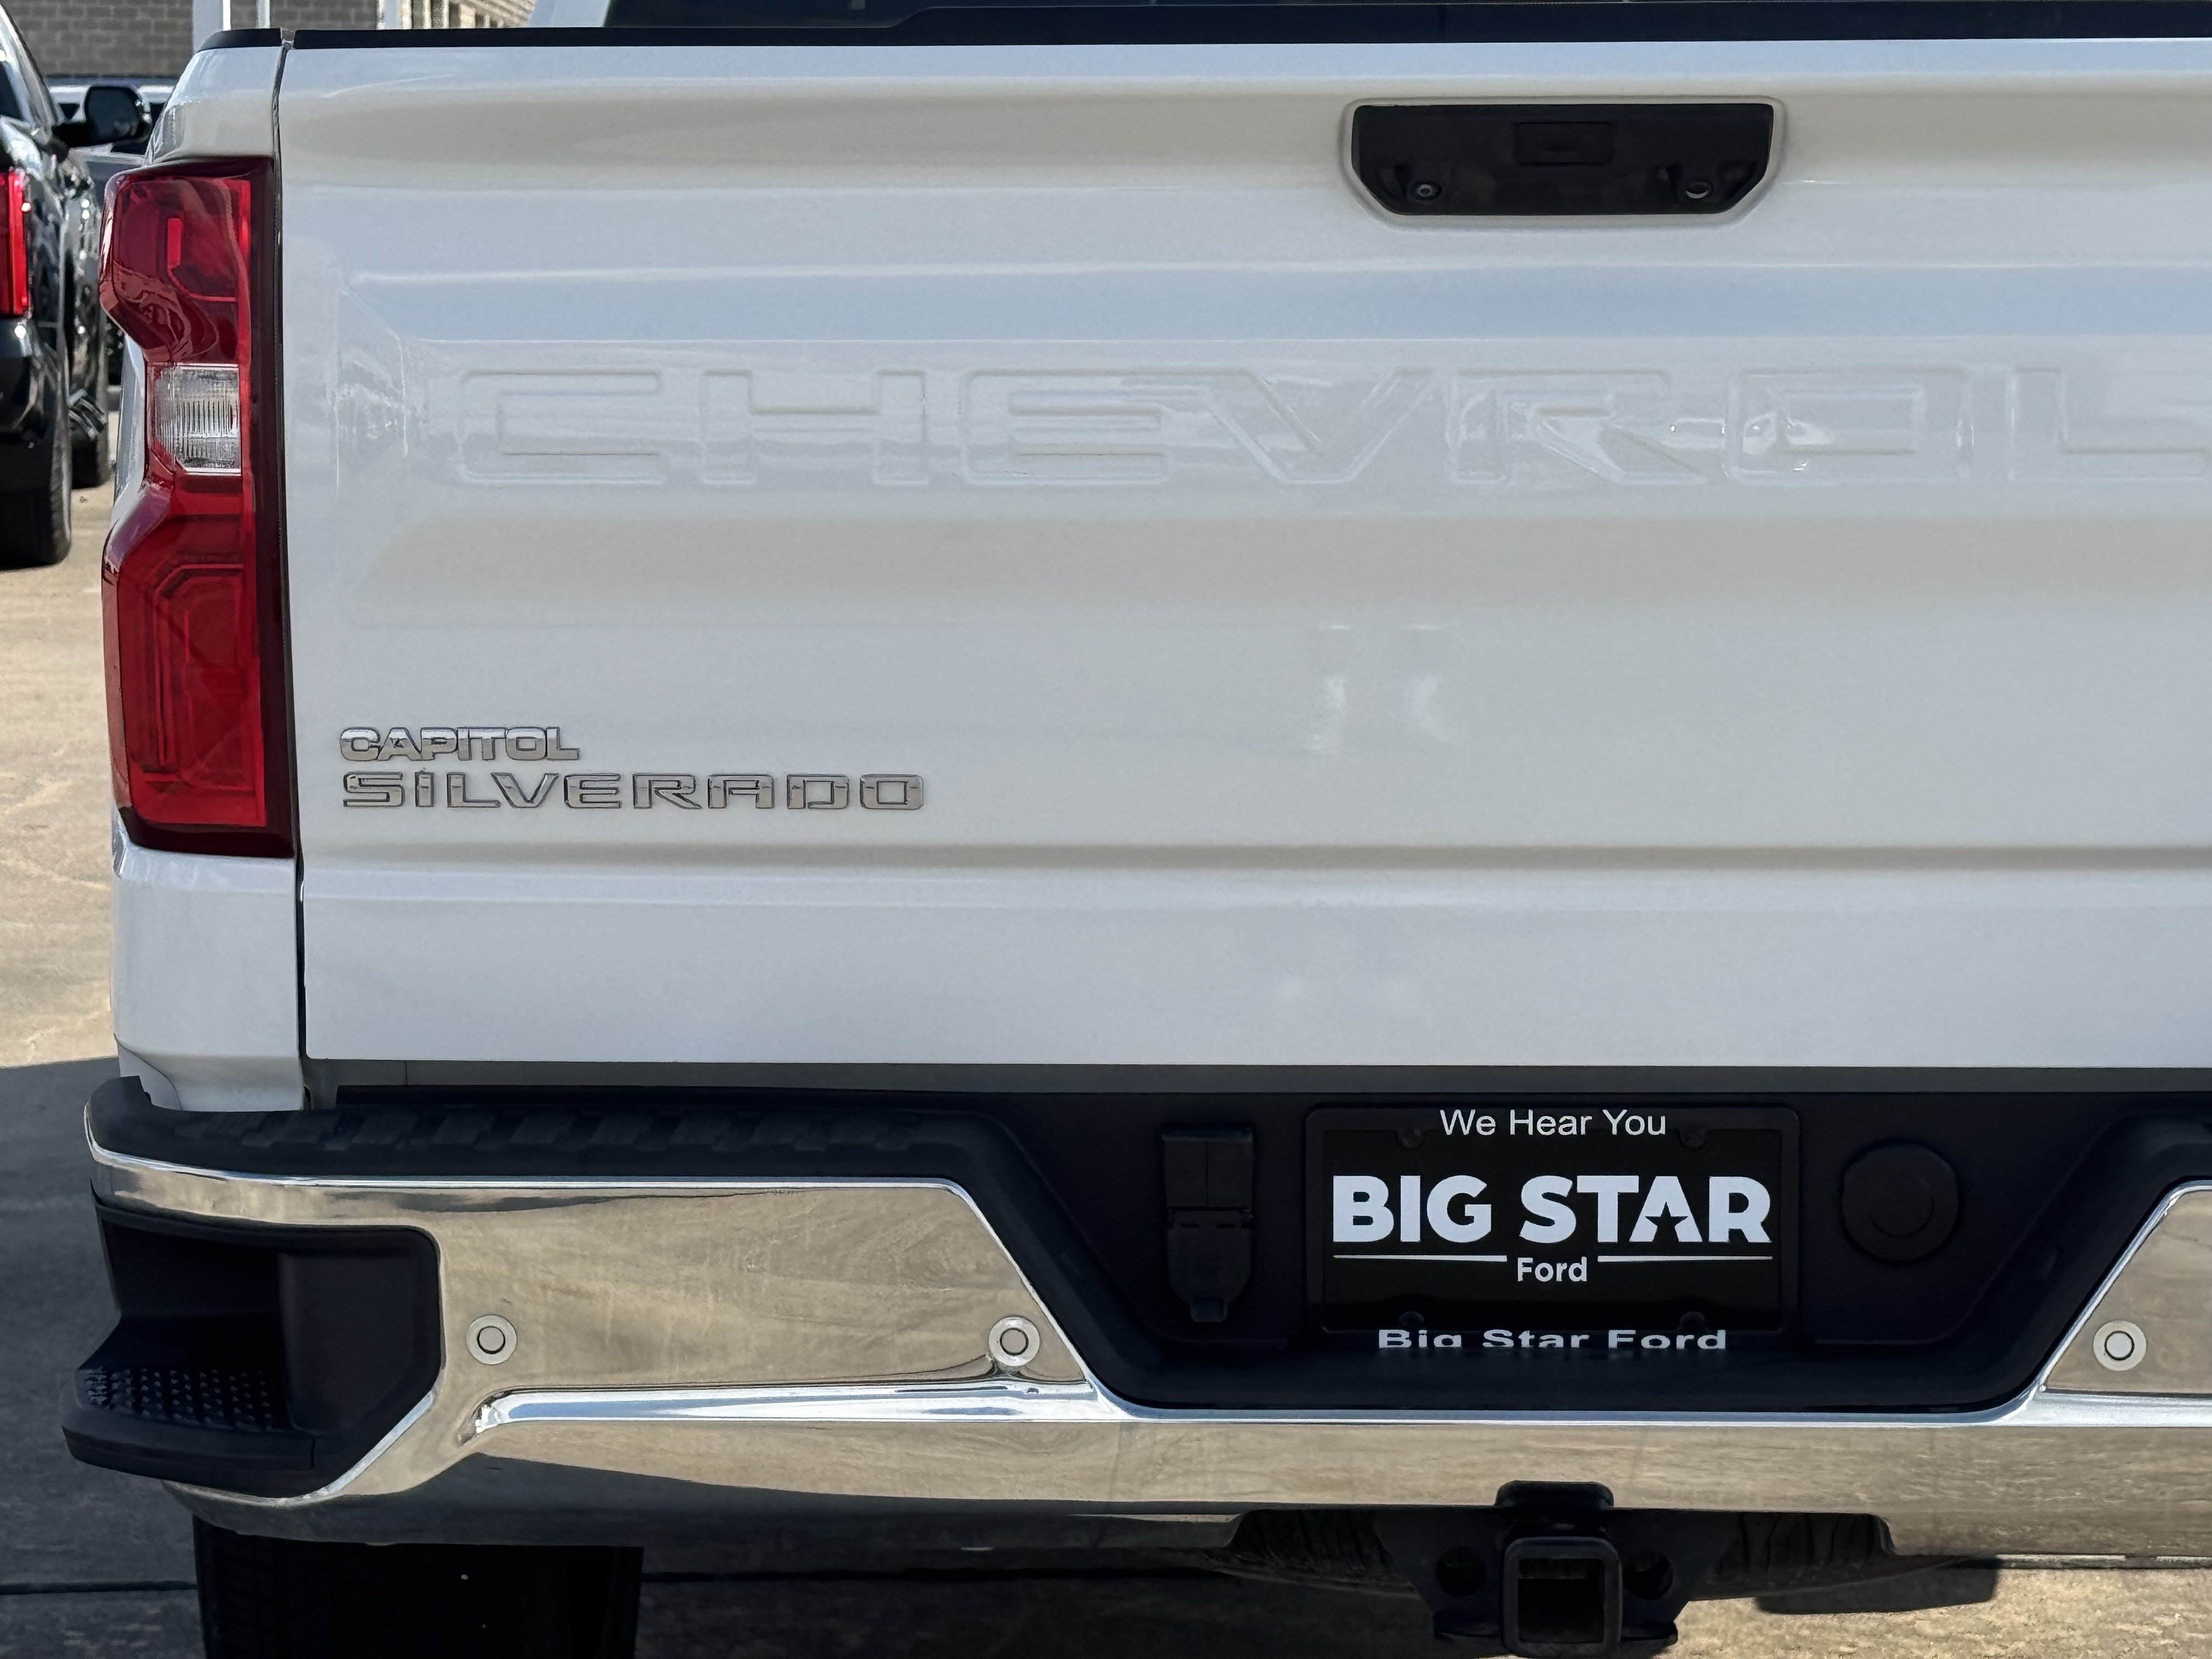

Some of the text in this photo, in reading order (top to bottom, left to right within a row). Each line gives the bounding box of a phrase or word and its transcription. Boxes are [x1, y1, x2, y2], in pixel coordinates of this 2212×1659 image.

[340, 726, 580, 761] CAPITOL
[343, 770, 924, 811] SILVERADO
[1440, 1109, 1666, 1136] We Hear You
[1333, 1175, 1772, 1243] BIG STAR
[1517, 1256, 1588, 1283] Ford
[1378, 1329, 1726, 1350] Big Star Ford
